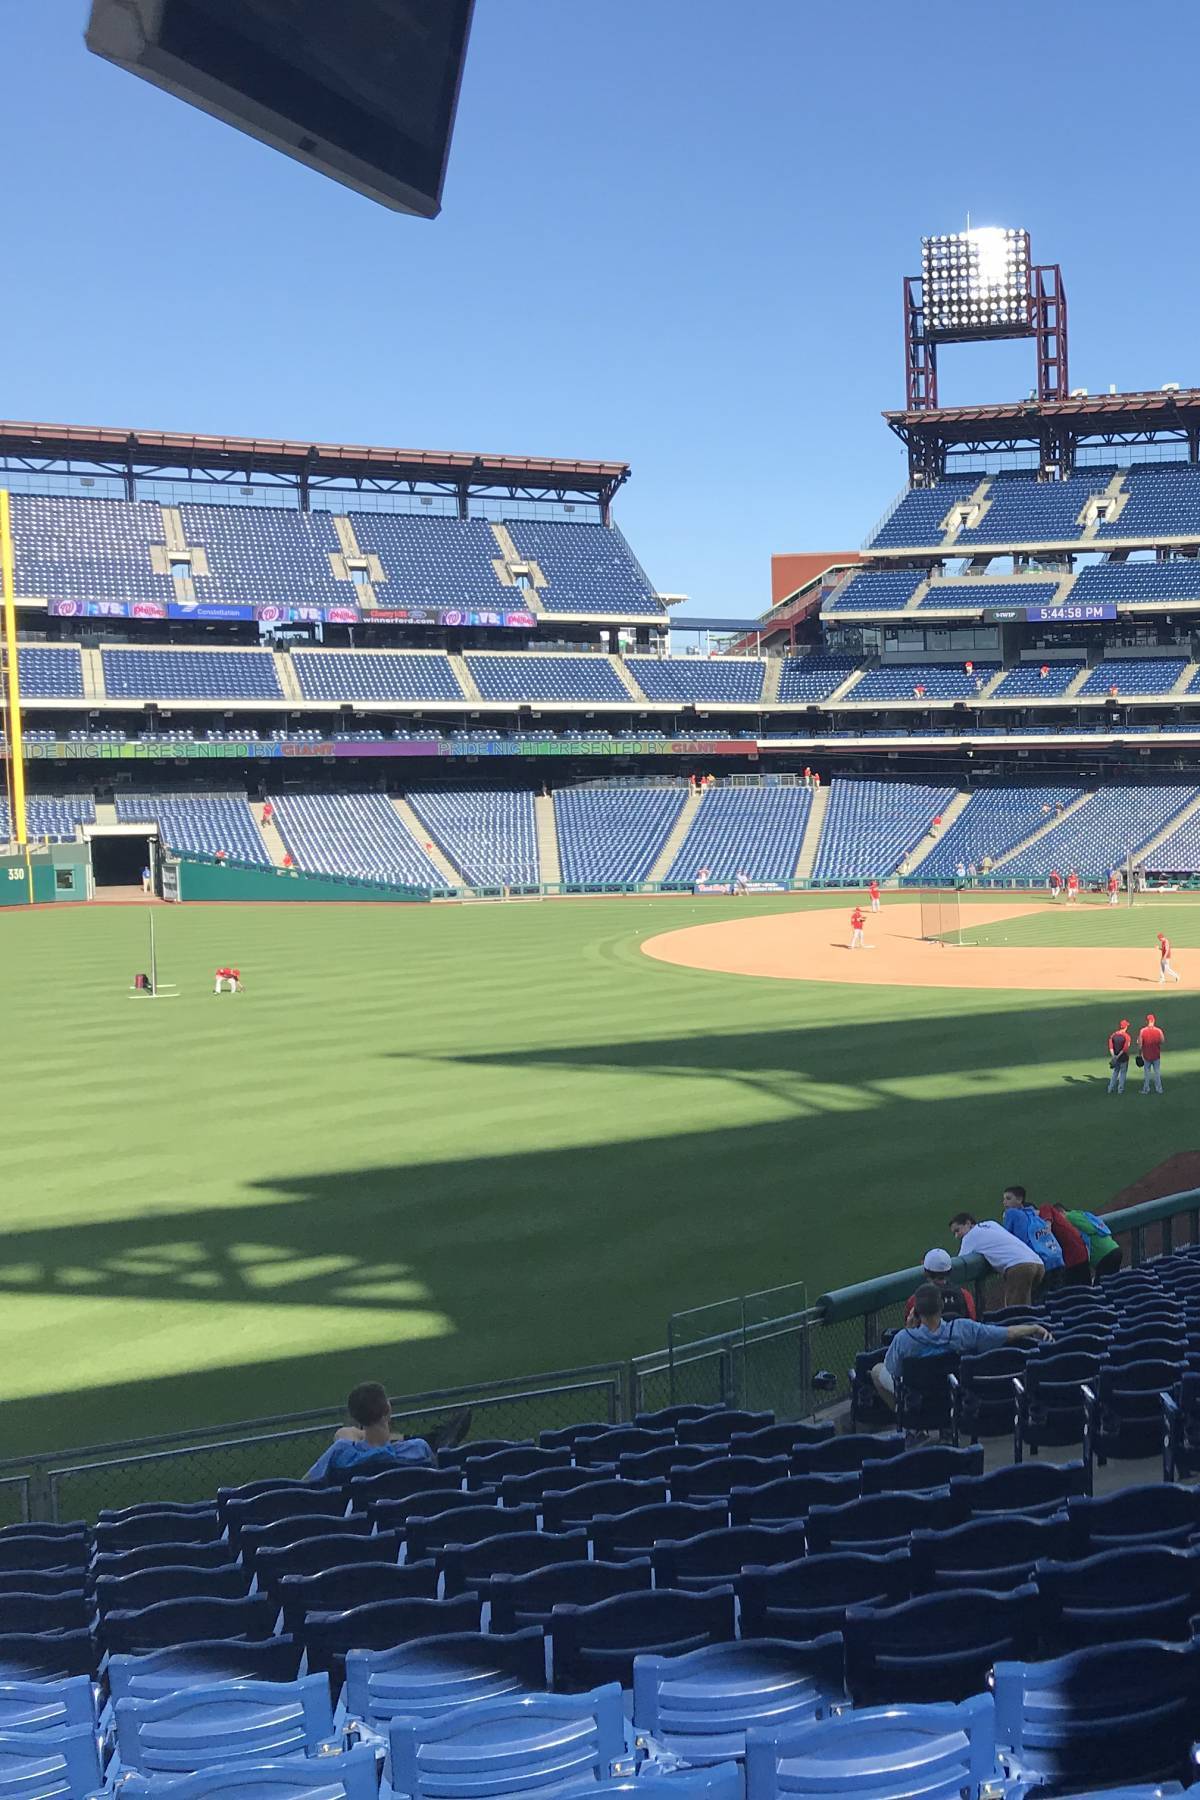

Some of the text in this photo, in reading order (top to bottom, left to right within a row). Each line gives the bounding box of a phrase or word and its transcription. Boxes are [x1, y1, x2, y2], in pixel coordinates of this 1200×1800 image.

[1040, 606, 1103, 619] 5:44:58 PM
[363, 617, 435, 625] winnerford.com
[64, 743, 126, 758] NIGHT
[134, 743, 247, 758] PRESENTED
[253, 743, 277, 757] BY
[281, 742, 335, 757] GIANT
[438, 741, 717, 755] PRIDE NIGHT PRESENTED BY GIANT
[8, 868, 24, 880] 330
